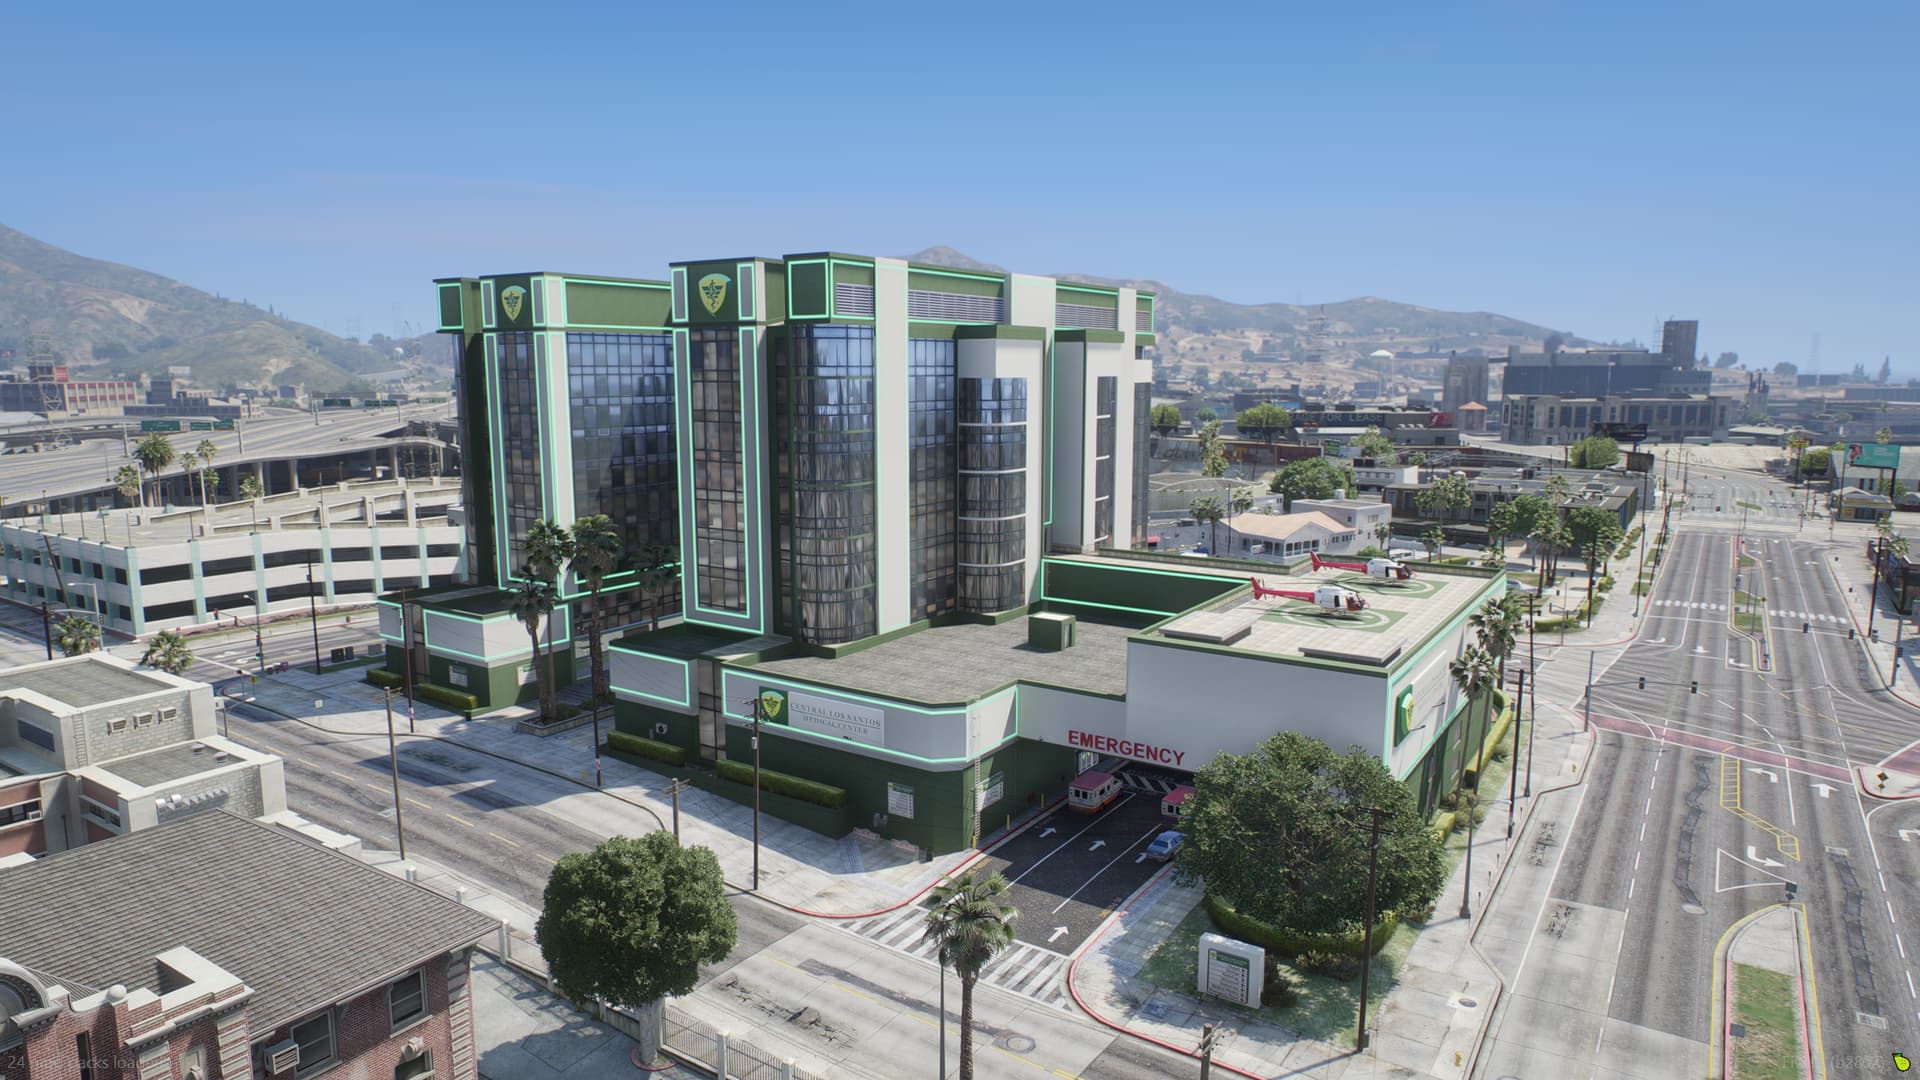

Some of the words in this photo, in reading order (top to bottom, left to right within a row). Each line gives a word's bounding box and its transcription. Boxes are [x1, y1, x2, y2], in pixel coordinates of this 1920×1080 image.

[1320, 413, 1342, 422] FOR
[1348, 413, 1383, 422] LEASE
[790, 703, 828, 716] CENTRAL
[847, 711, 881, 727] SANTOS
[1068, 730, 1185, 766] EMERGENCY
